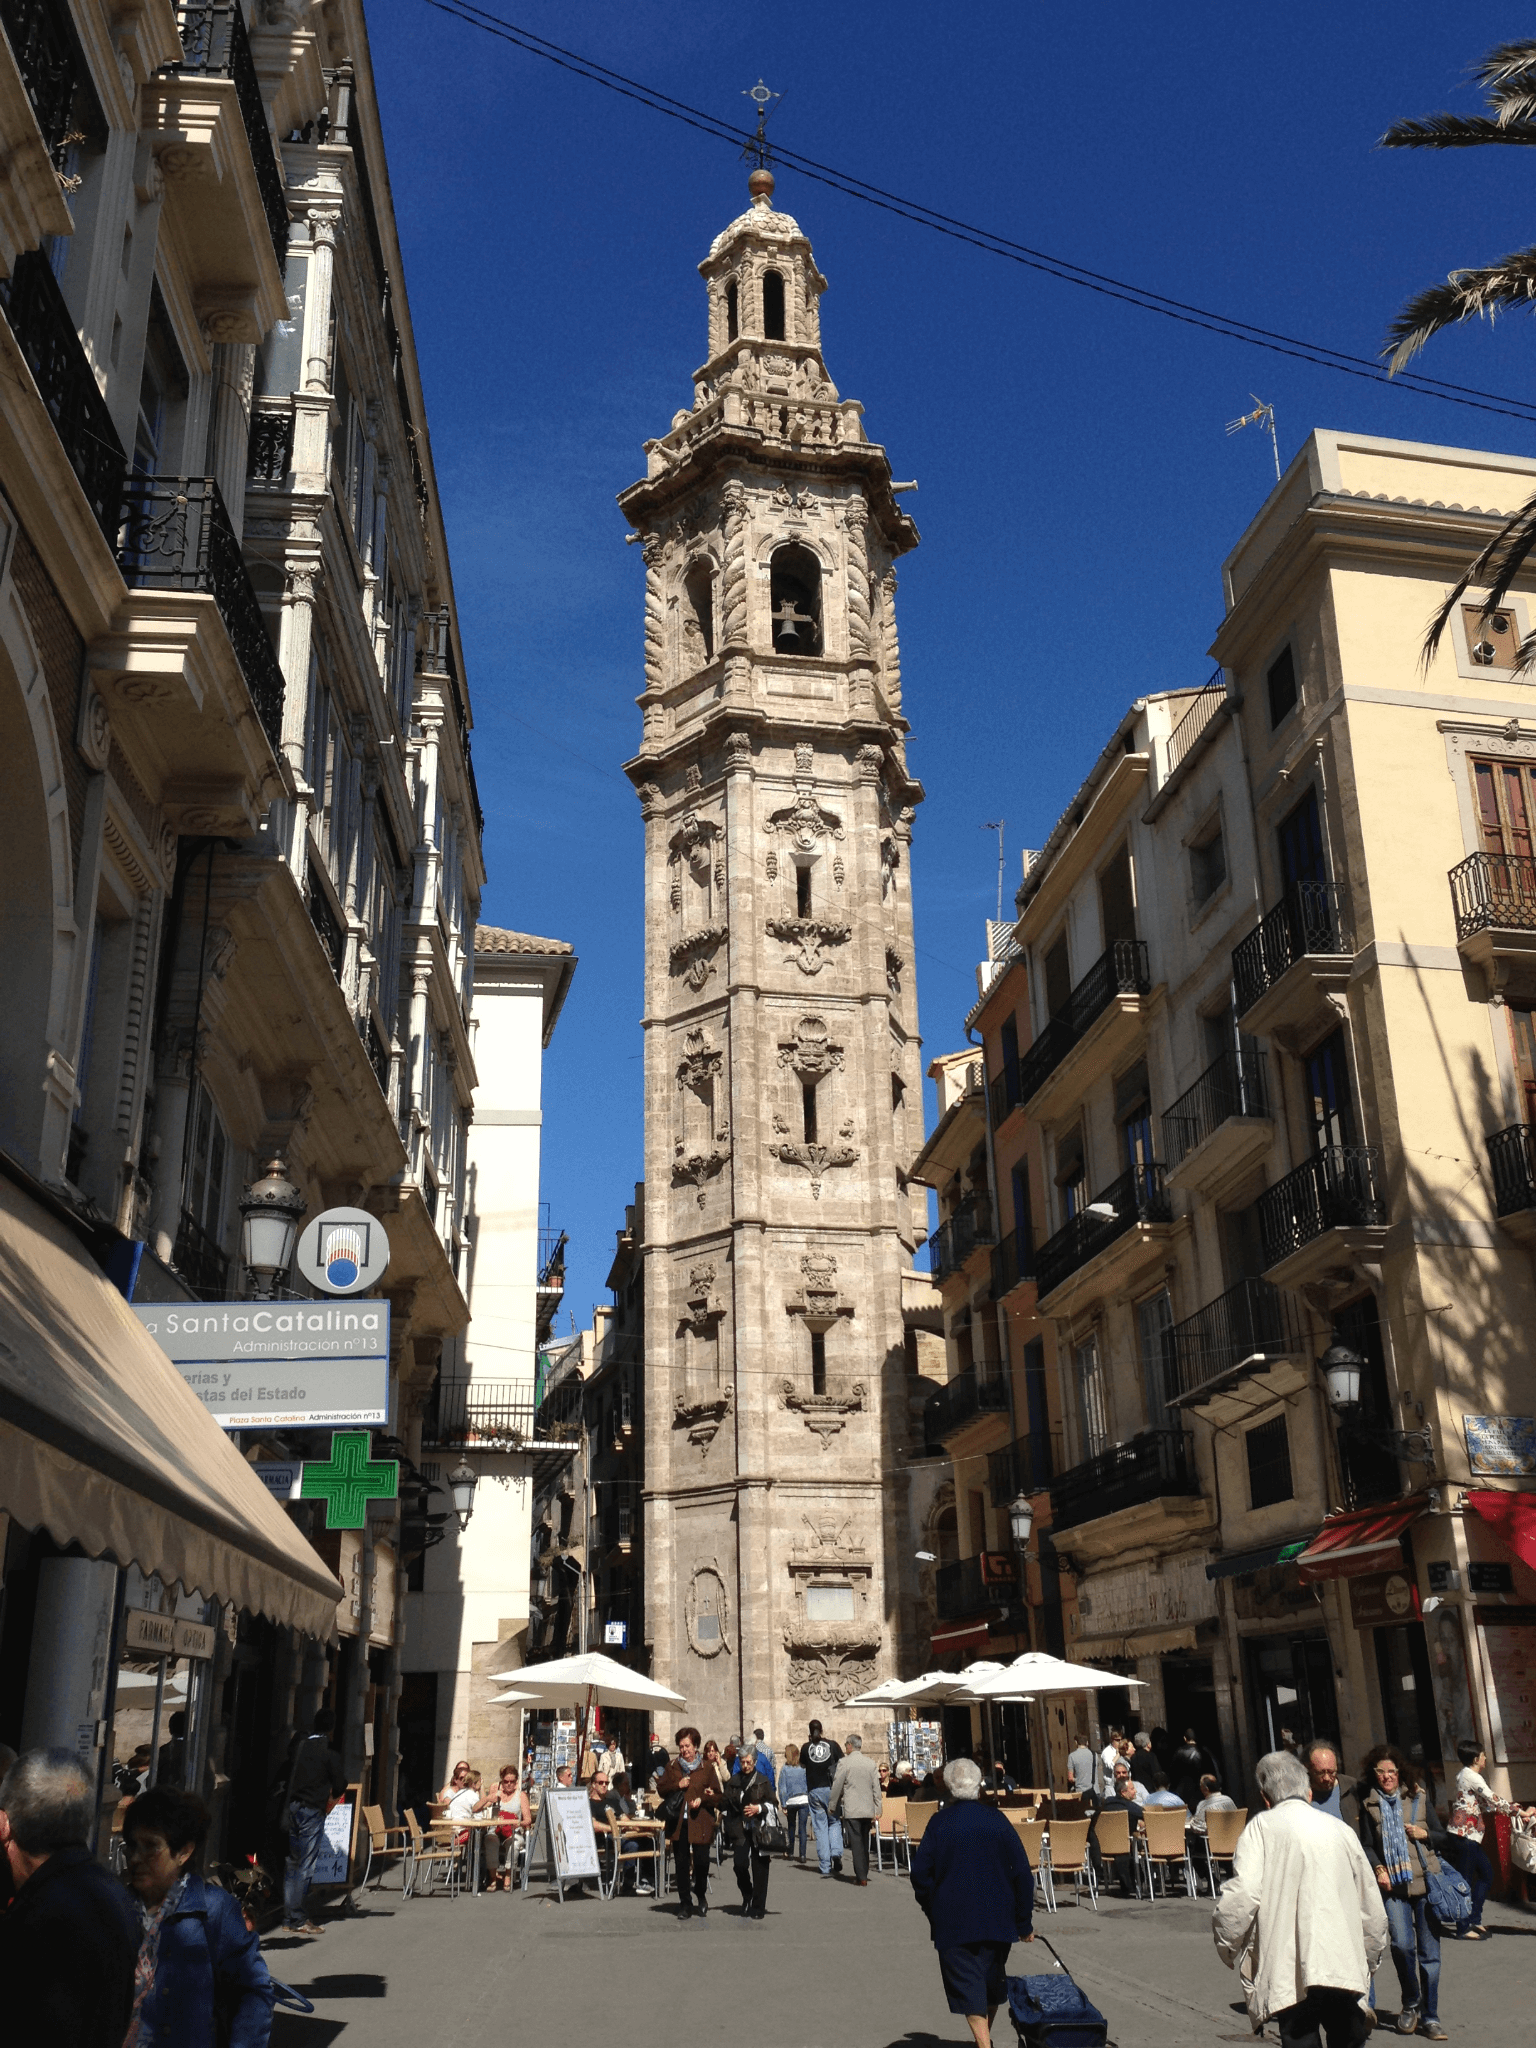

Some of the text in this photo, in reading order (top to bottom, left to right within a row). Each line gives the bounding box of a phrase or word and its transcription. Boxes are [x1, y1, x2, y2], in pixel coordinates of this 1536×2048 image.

[233, 1338, 340, 1353] Administración
[222, 1373, 232, 1387] y
[230, 1388, 253, 1401] del
[257, 1386, 307, 1401] Estado
[273, 1415, 306, 1423] Catalina
